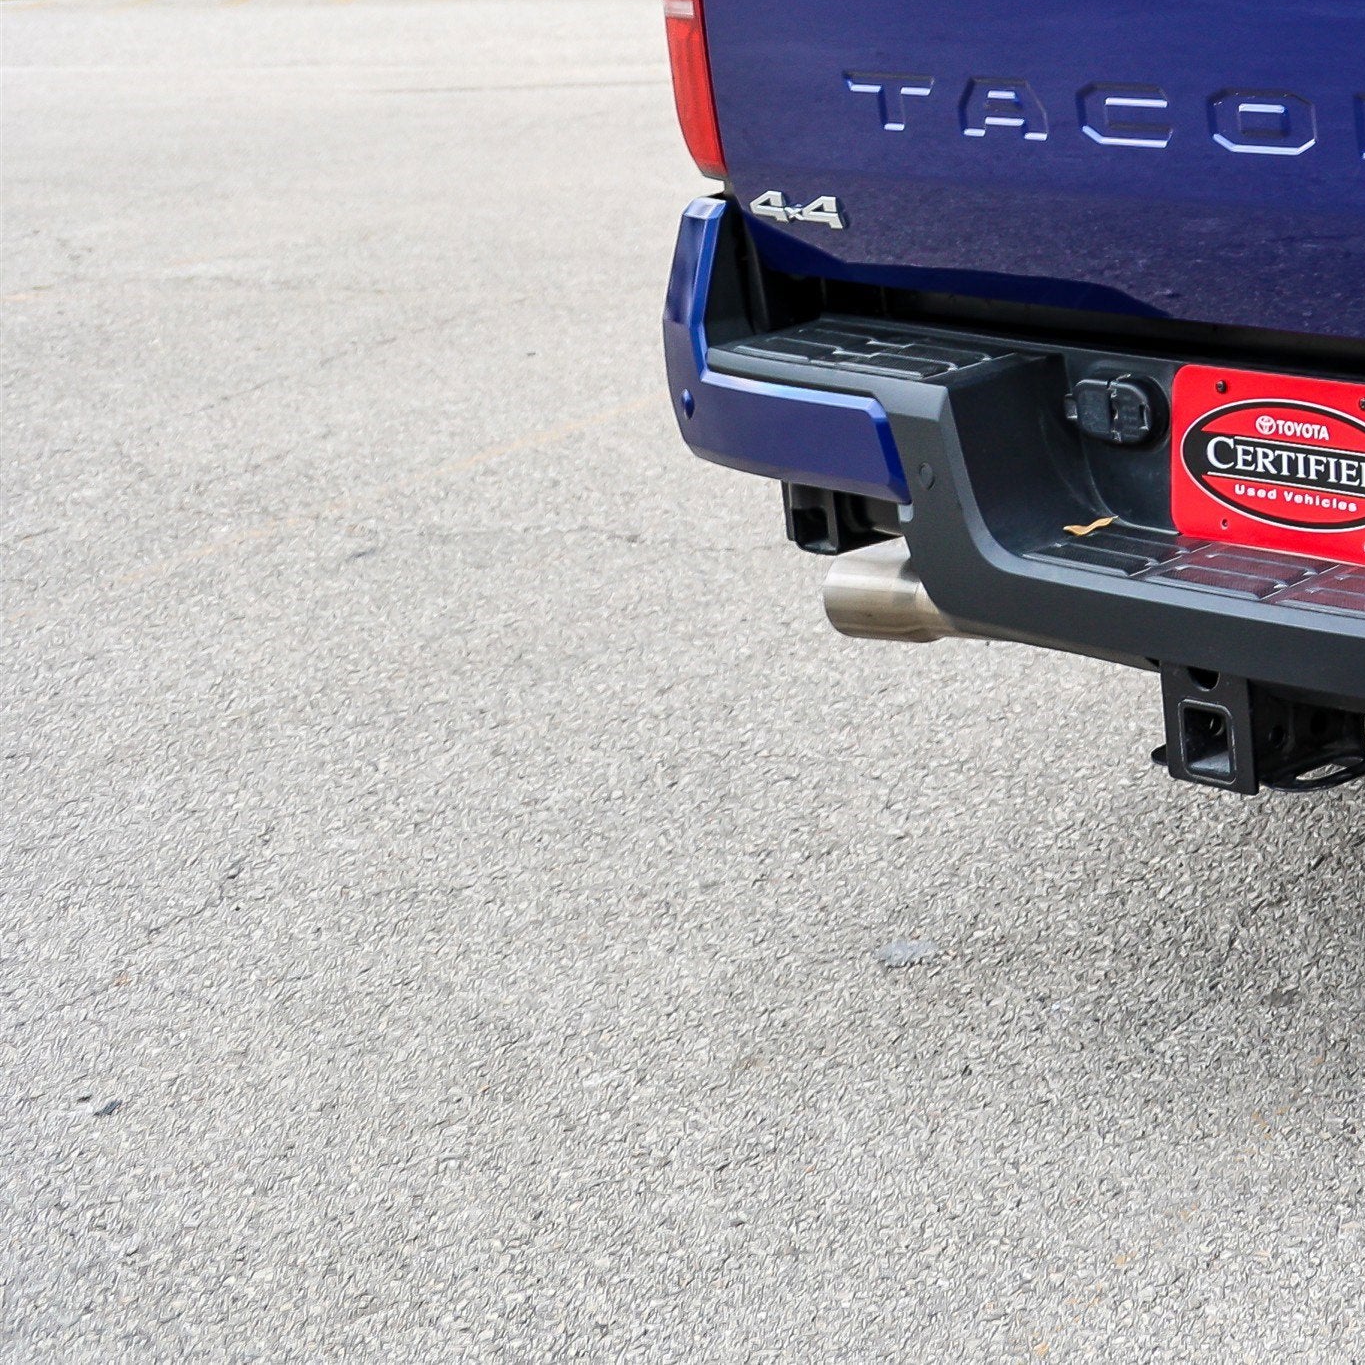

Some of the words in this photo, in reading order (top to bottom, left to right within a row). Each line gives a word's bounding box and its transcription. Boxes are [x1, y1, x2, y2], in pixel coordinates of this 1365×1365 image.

[1276, 419, 1330, 441] TOYOTA
[1234, 483, 1277, 500] Used
[1284, 491, 1358, 513] Vehicles
